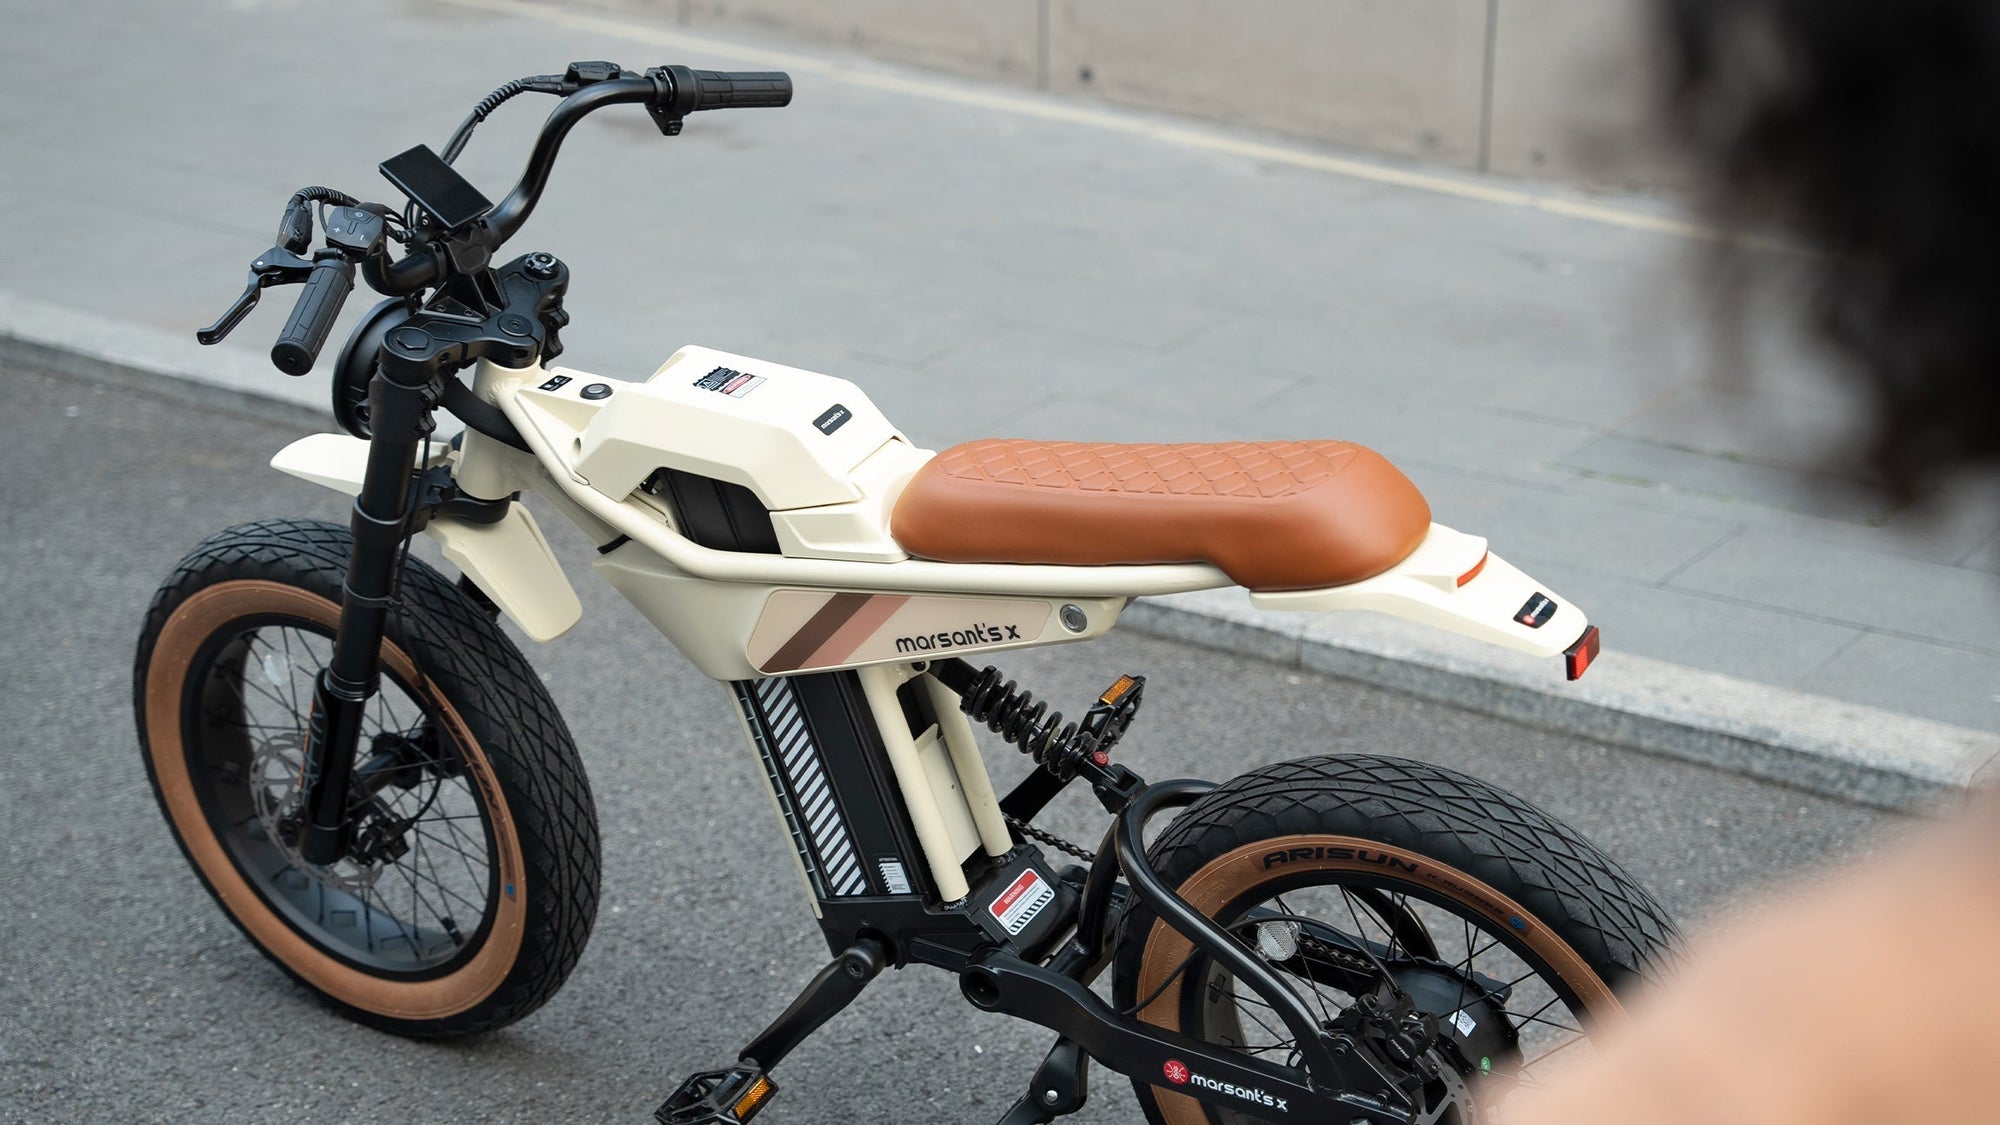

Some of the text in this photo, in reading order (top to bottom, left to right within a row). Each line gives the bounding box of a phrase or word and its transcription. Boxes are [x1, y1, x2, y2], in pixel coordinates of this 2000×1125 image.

[895, 622, 1003, 653] marsant's
[1263, 847, 1419, 873] ARISUN
[1003, 884, 1024, 905] WARNING
[1190, 1074, 1274, 1107] marsant's
